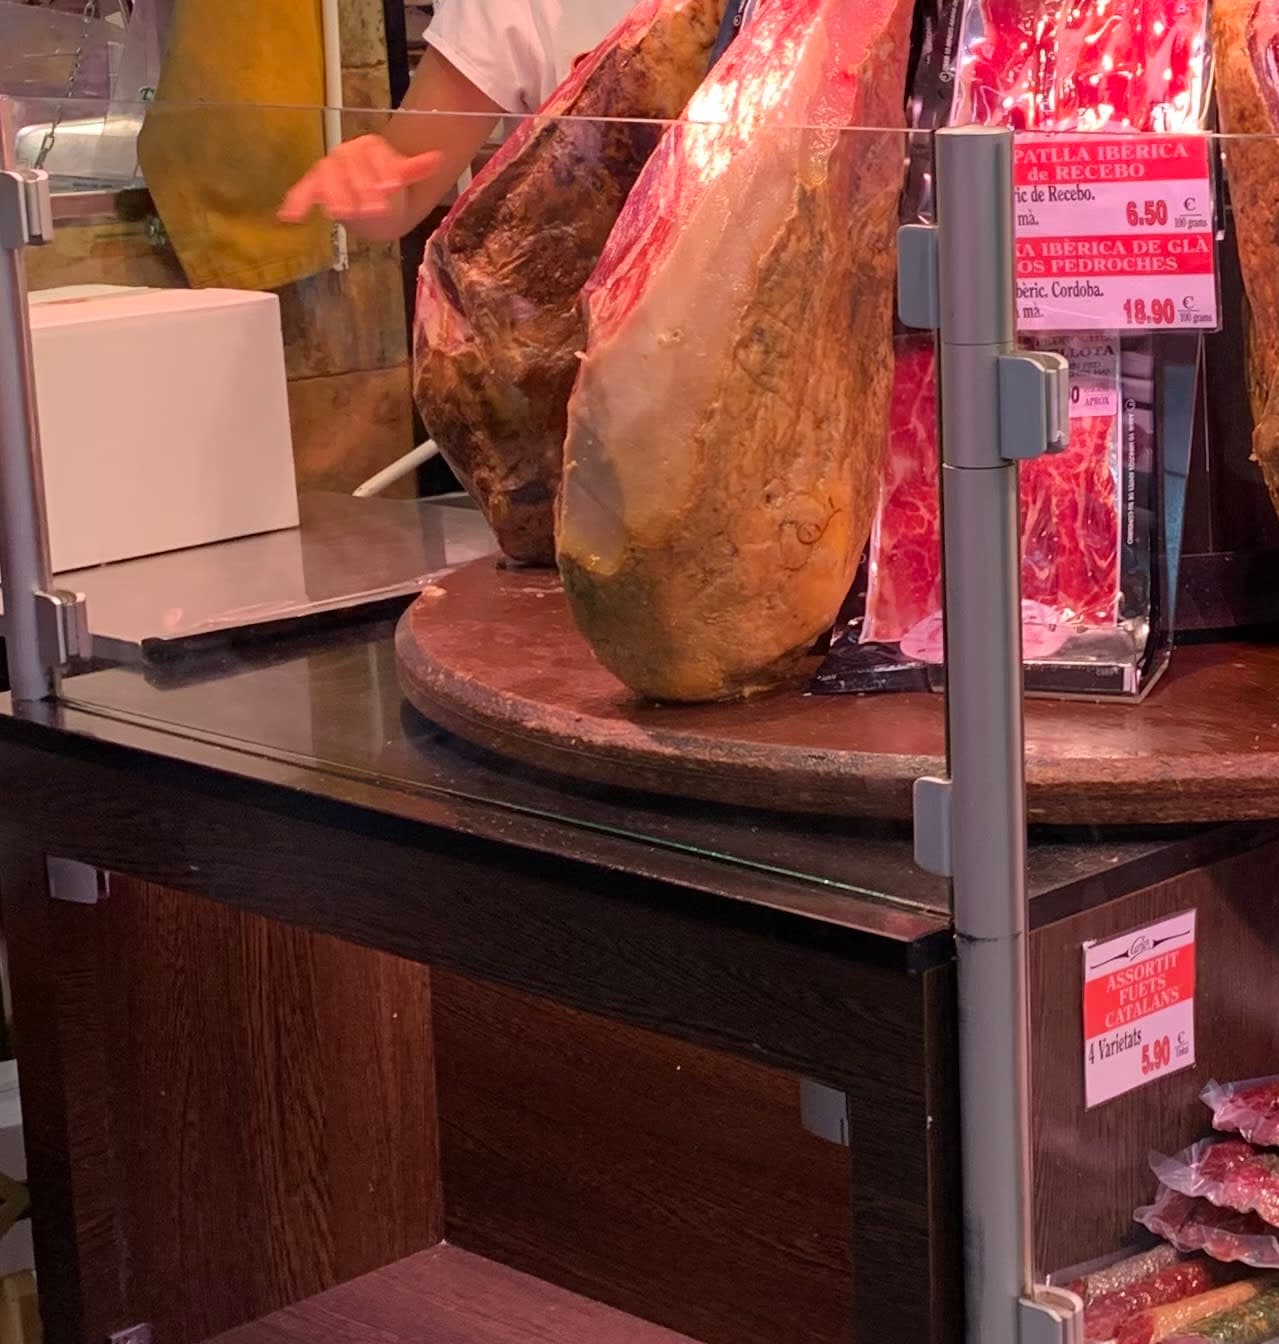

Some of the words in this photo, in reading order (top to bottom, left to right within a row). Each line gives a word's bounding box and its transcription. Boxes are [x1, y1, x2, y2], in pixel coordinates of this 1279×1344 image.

[1028, 167, 1048, 181] de
[1055, 162, 1145, 180] RECEBO
[1031, 185, 1044, 202] de
[1049, 184, 1095, 202] Recebo.
[1018, 212, 1039, 226] mà.
[1126, 199, 1168, 226] 6.50
[1184, 197, 1196, 211] €
[1042, 236, 1124, 256] IBÈRICA
[1133, 239, 1161, 254] DE
[1168, 235, 1209, 254] GLÀ
[1016, 259, 1045, 273] OS
[1052, 256, 1178, 273] PEDROCHES
[1052, 280, 1104, 297] Cordoba.
[1023, 303, 1044, 319] mà.
[1123, 298, 1175, 324] 18.90
[1183, 296, 1194, 309] €
[1106, 951, 1179, 993] ASSORTIT
[1120, 973, 1166, 1005] FUETS
[1105, 988, 1179, 1028] CATALANS
[1089, 1041, 1094, 1064] 4
[1099, 1028, 1142, 1060] Varietats
[1141, 1035, 1170, 1075] 5.90
